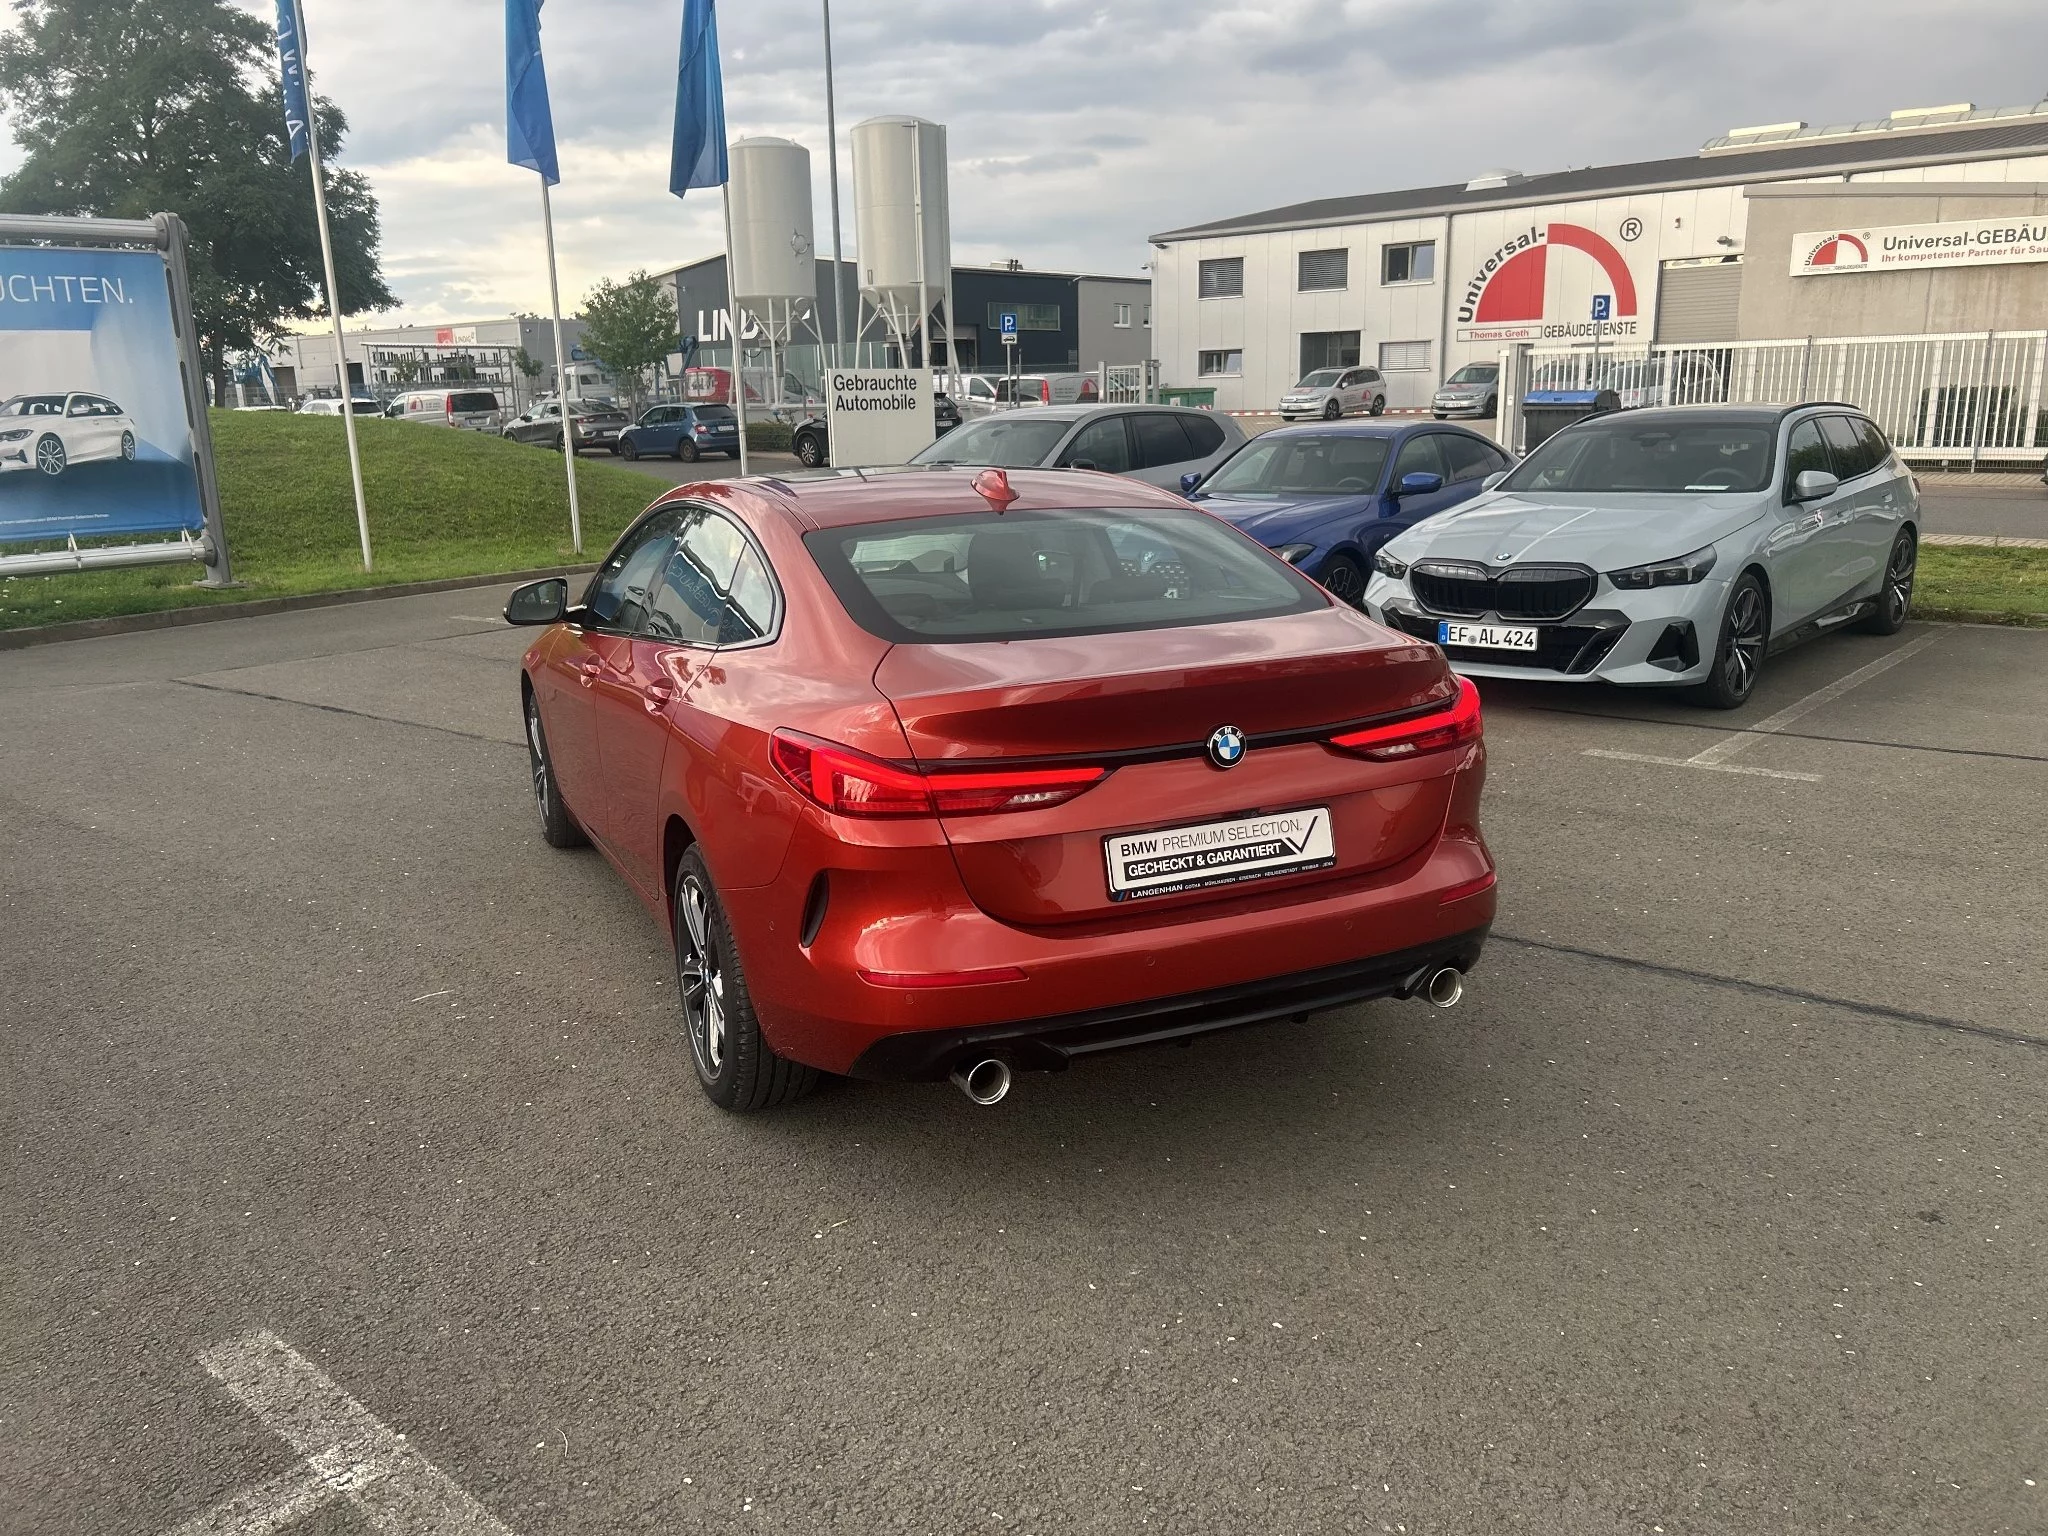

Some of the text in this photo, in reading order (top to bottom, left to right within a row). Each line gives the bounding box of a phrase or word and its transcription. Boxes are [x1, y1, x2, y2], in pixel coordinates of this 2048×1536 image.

[1883, 223, 2047, 251] Universal-GEBÄU
[1804, 234, 1837, 266] Universal-
[1881, 254, 1896, 262] Ihr
[1898, 251, 1965, 262] kompetenter
[1968, 247, 2007, 258] Partner
[2010, 246, 2026, 255] für
[1457, 226, 1546, 323] Universal-
[1595, 297, 1606, 318] P
[1004, 316, 1014, 332] P
[1543, 321, 1637, 339] GEBÄUDEDIENSTE
[1469, 330, 1503, 340] Thomas
[833, 374, 917, 391] Gebrauchte
[835, 393, 916, 411] Automobile
[1449, 626, 1469, 642] EF
[1479, 628, 1500, 645] AL
[1503, 630, 1534, 647] 424
[1121, 839, 1158, 857] BMW
[1162, 829, 1225, 851] PREMIUM
[1128, 842, 1282, 877] GECHECKT & GARANTIERT
[1131, 883, 1183, 899] LANGENHAN
